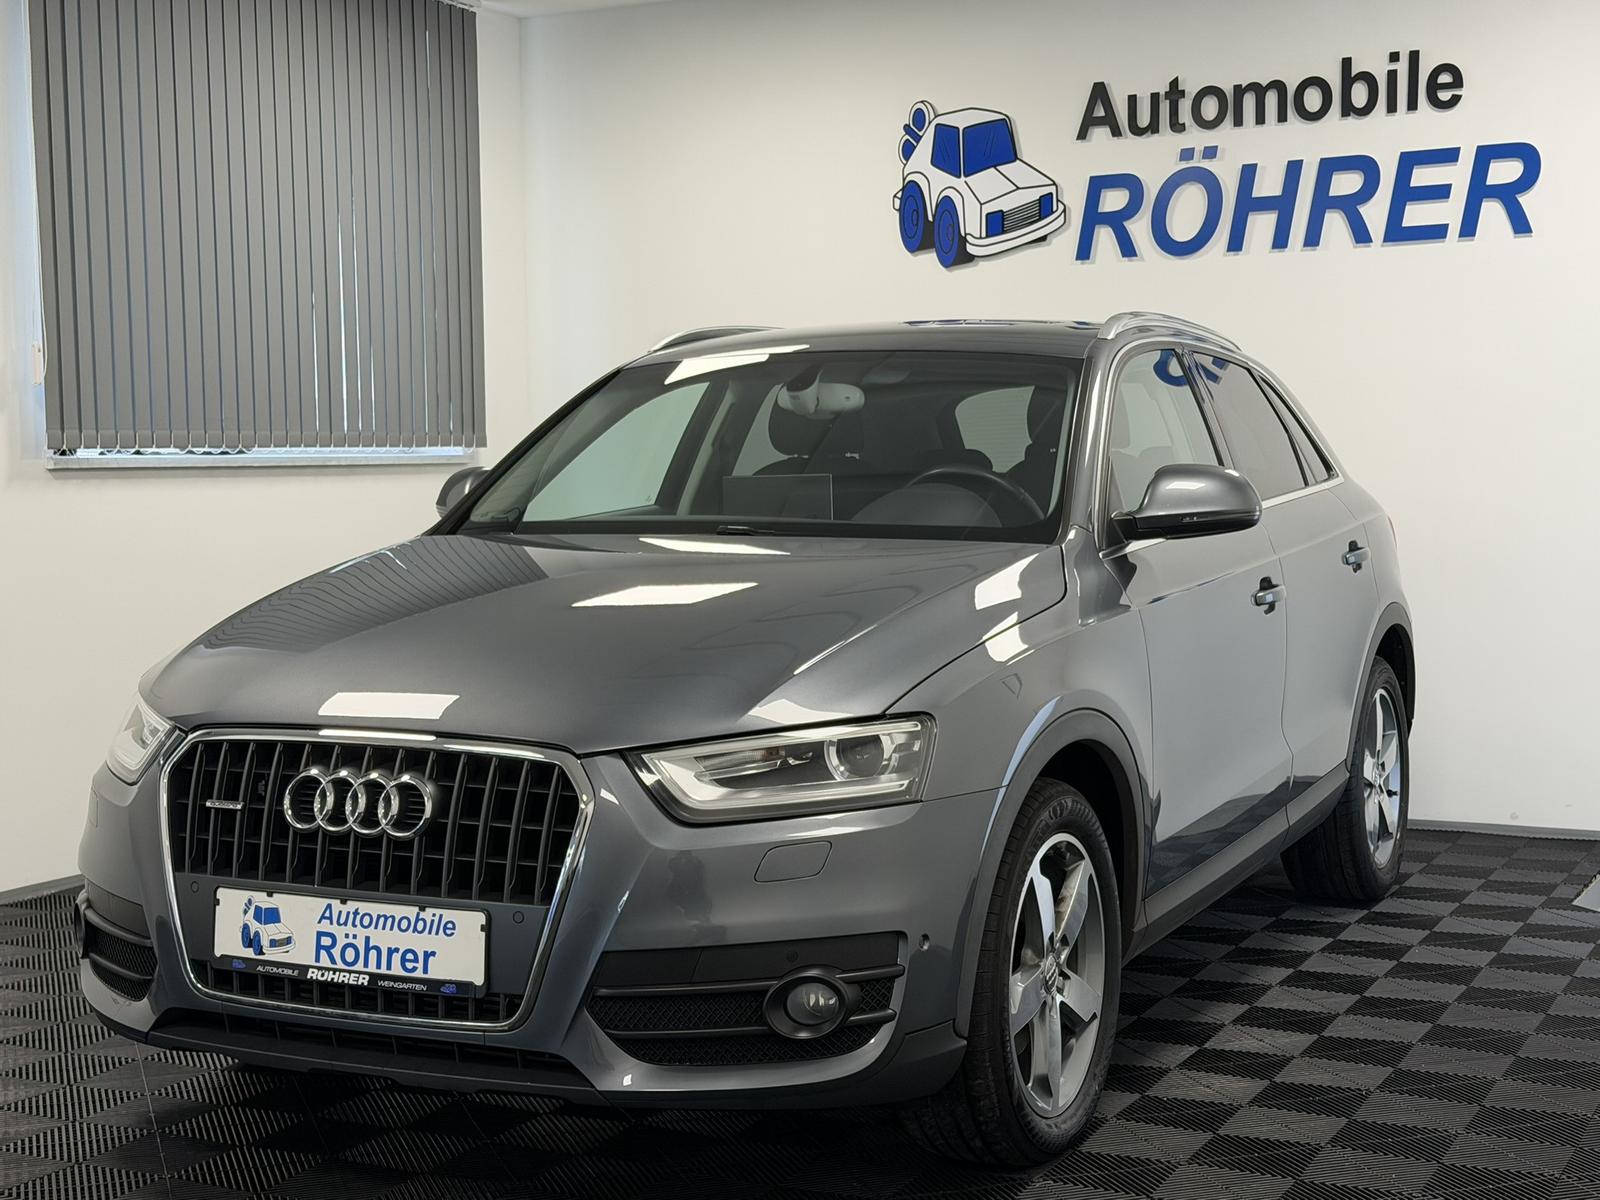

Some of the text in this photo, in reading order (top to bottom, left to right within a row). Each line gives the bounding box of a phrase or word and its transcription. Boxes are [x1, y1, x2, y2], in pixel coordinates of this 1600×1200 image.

[1076, 50, 1464, 141] Automobile
[1075, 142, 1542, 262] RÖHRER
[317, 903, 456, 937] Automobile
[314, 930, 437, 975] Röhrer
[255, 965, 427, 992] AUTOMOBILE RÖHRER WEINGARTEN
